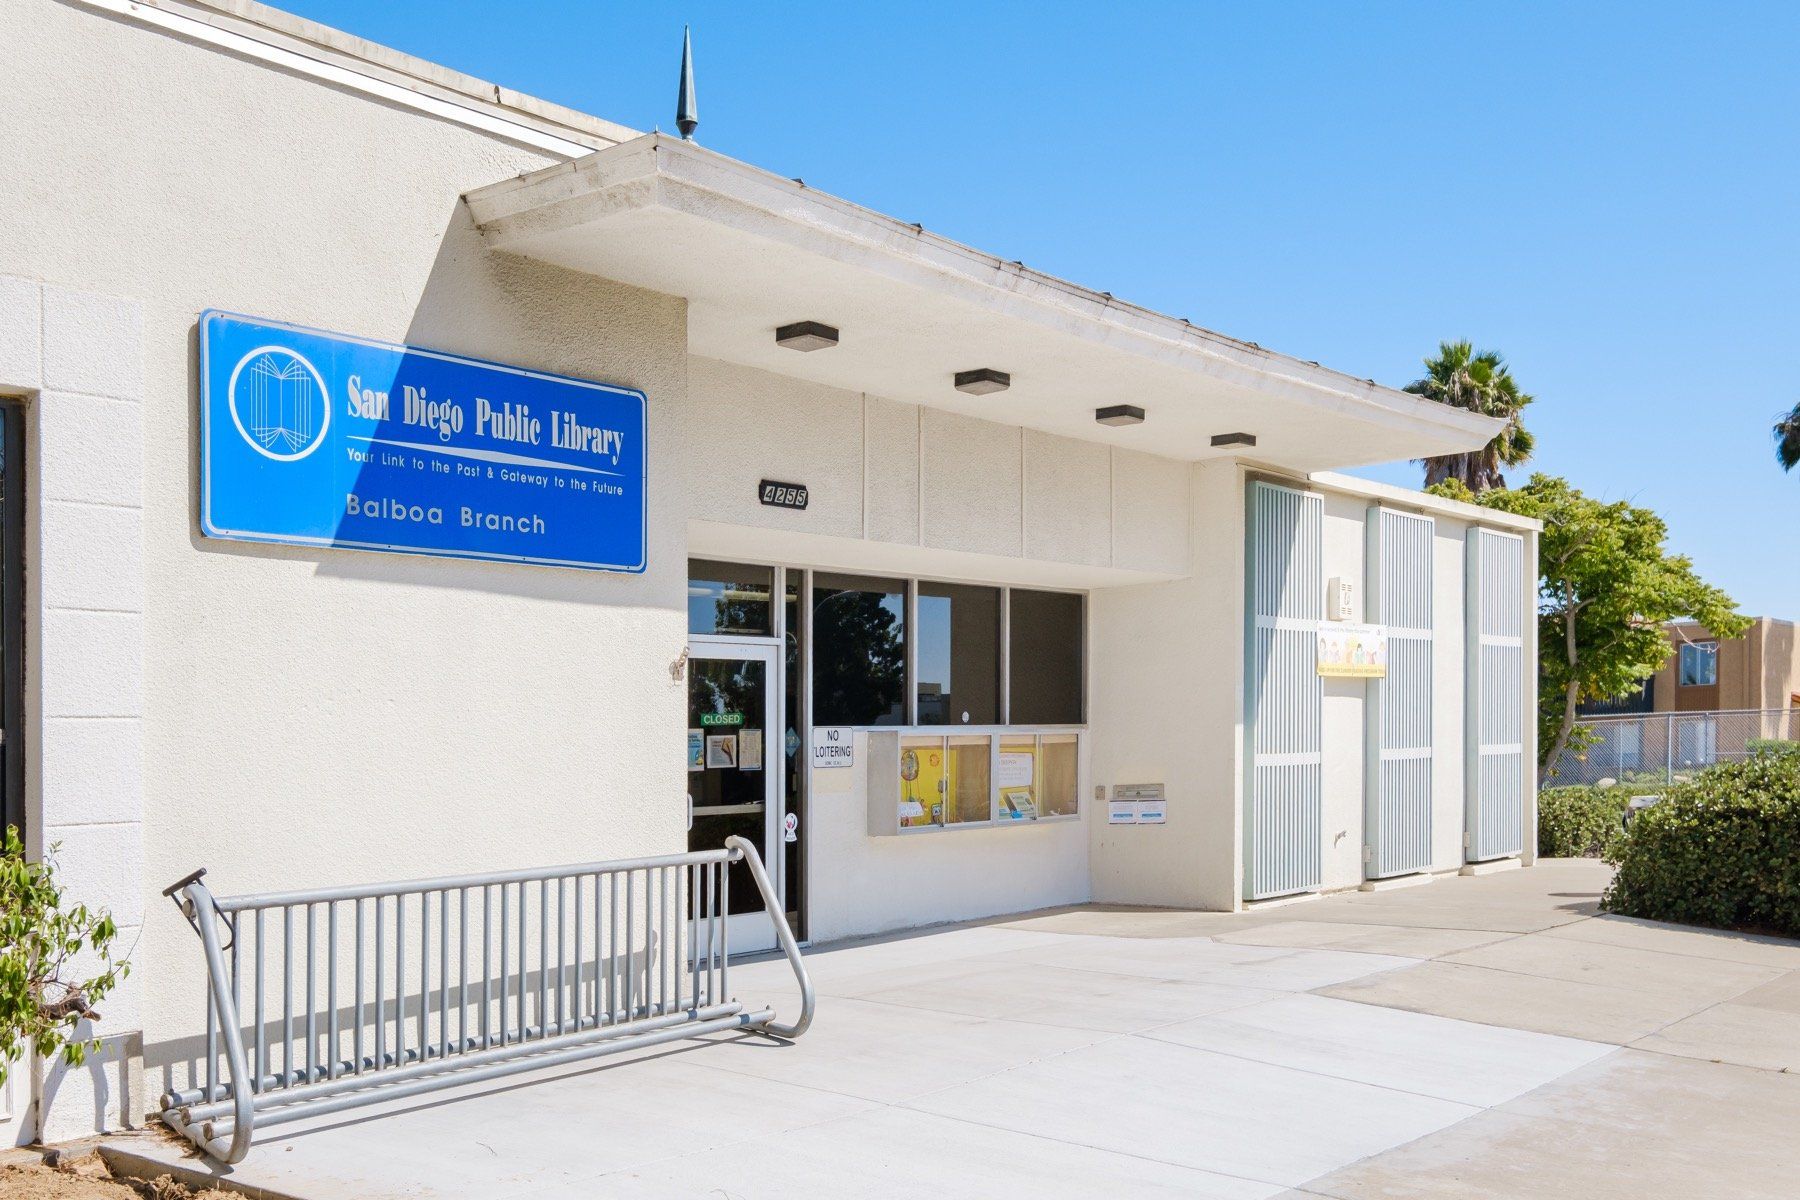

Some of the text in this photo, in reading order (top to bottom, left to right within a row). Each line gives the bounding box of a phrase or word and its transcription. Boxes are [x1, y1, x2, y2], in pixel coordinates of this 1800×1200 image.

[347, 374, 625, 466] San Diego Public Library
[346, 447, 623, 496] Your Link to the Past & Gateway to the Future
[765, 486, 806, 504] 4255
[346, 493, 545, 534] Balboa Branch
[703, 714, 741, 725] CLOSED
[827, 729, 840, 742] NO
